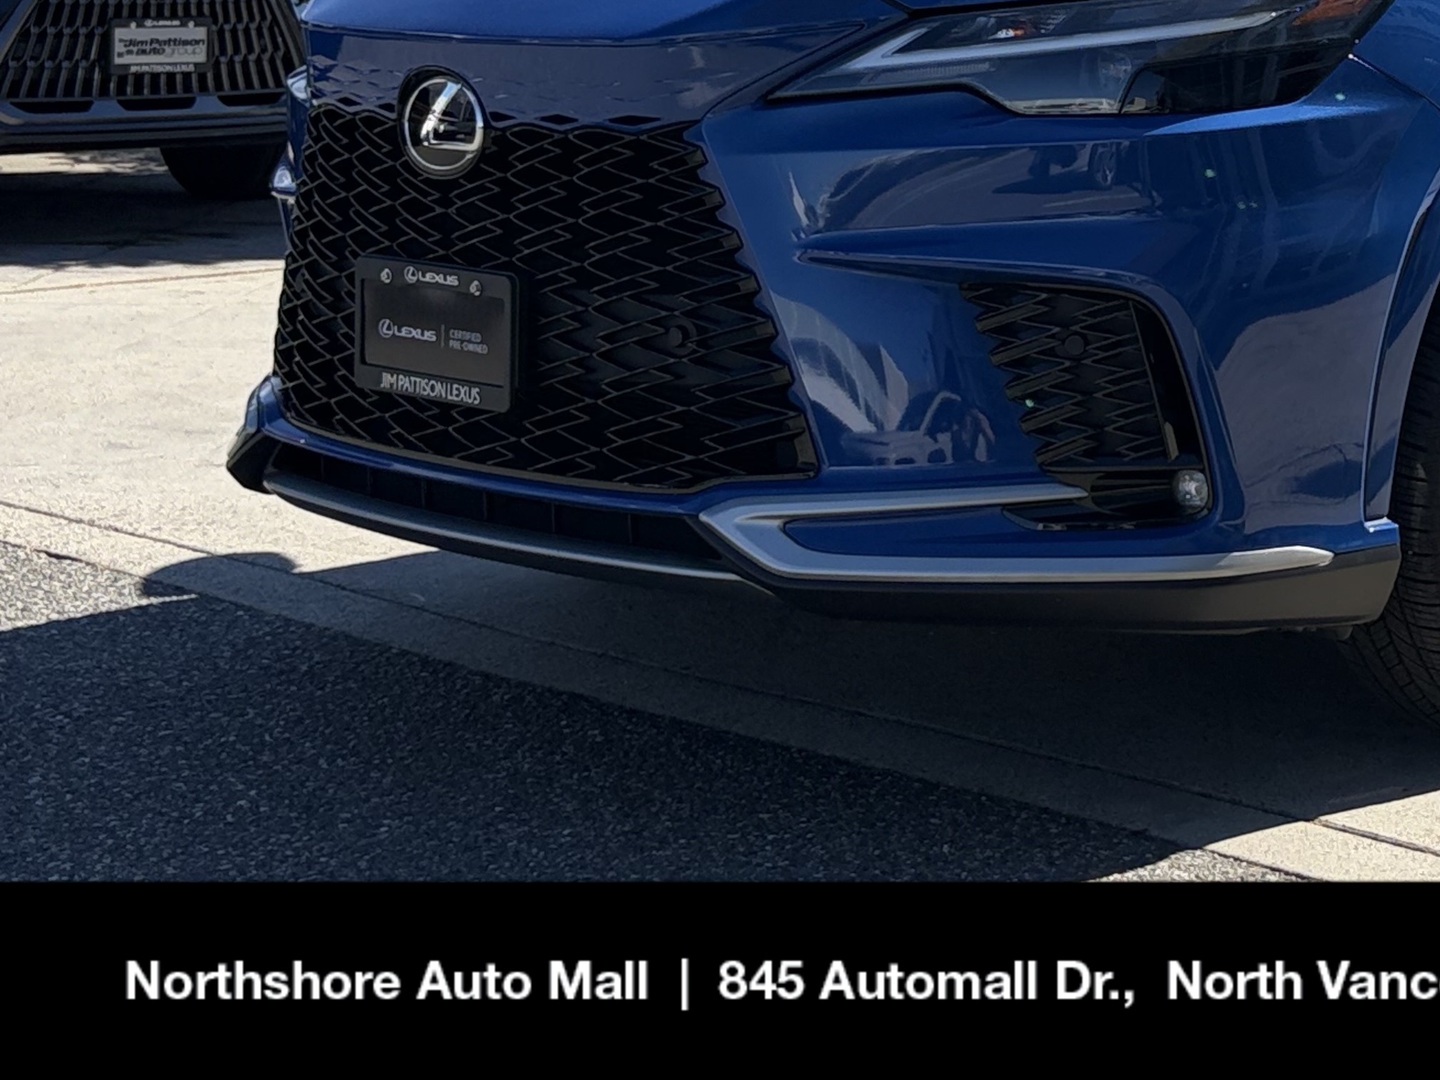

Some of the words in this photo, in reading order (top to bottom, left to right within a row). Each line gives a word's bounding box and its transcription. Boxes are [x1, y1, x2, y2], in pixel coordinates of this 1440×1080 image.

[418, 271, 460, 287] LEXUS
[394, 326, 438, 342] LEXUS
[380, 372, 397, 389] JIM
[399, 374, 446, 399] PATTISON
[447, 386, 481, 405] LEXUS
